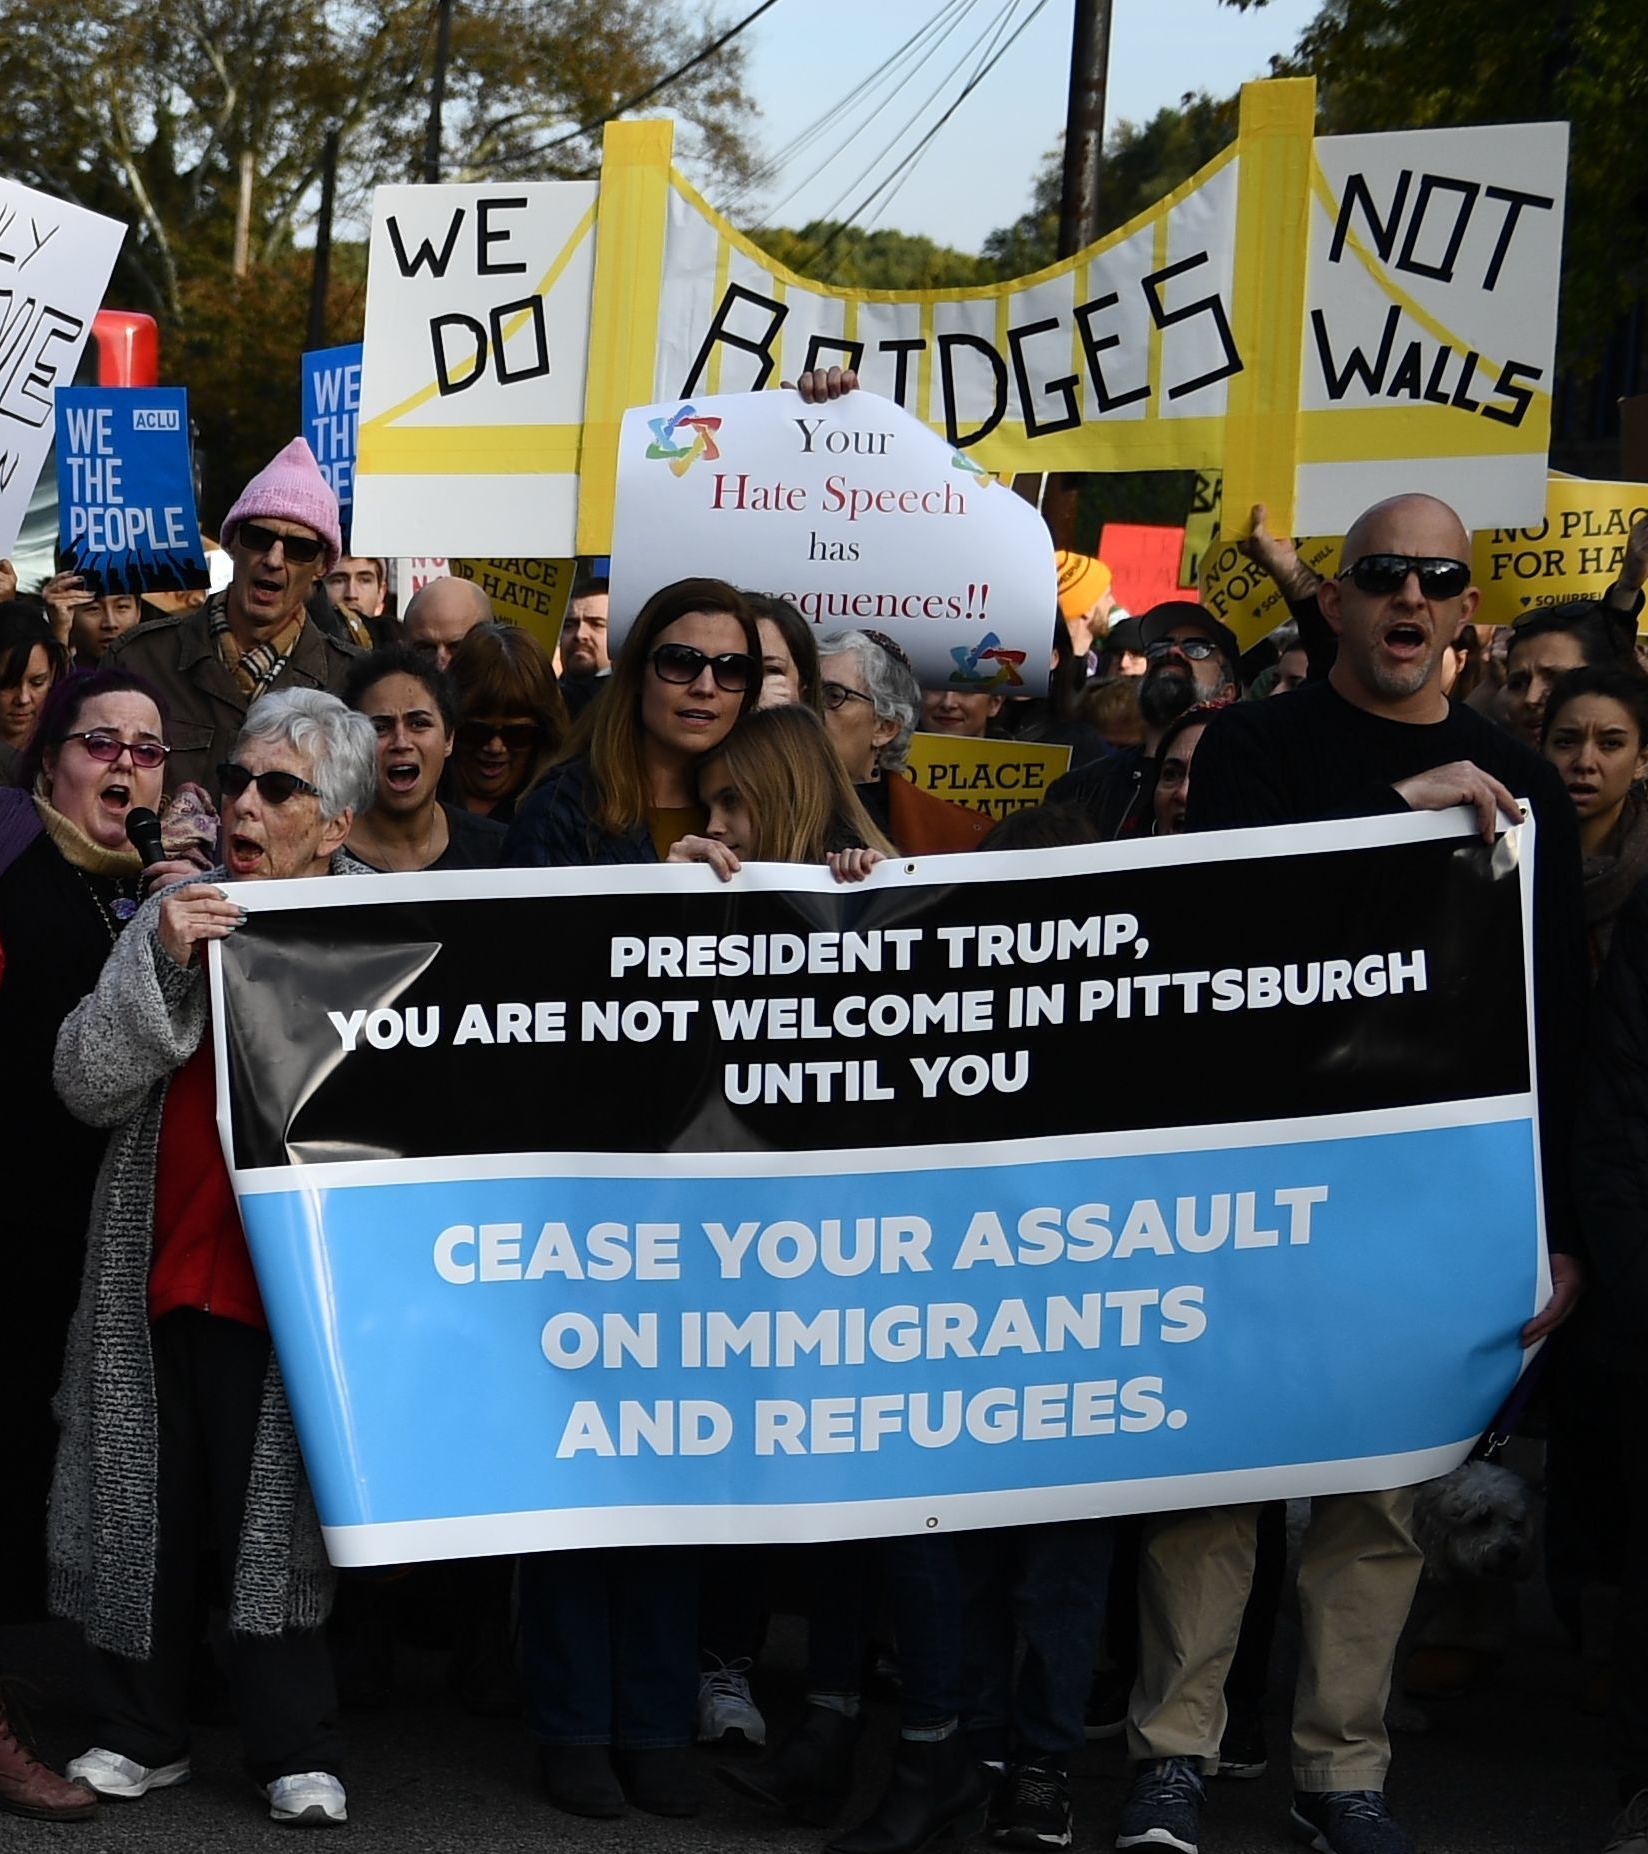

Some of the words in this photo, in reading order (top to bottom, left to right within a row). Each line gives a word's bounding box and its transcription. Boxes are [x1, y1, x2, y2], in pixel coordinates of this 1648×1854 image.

[386, 198, 527, 278] WE
[1329, 169, 1554, 291] NOT
[430, 294, 550, 397] DO
[1310, 304, 1543, 428] WALLS
[313, 364, 361, 415] WE
[66, 408, 113, 455] WE
[135, 411, 177, 429] ACLU
[793, 417, 895, 455] Your
[66, 457, 124, 505] THE
[710, 472, 807, 512] Hate
[821, 474, 967, 521] Speech
[70, 506, 189, 553] PEOPLE
[808, 531, 860, 562] has
[1491, 549, 1566, 581] FOR
[482, 573, 551, 617] HATE
[927, 763, 1045, 790] PLACE
[610, 928, 923, 978] PRESIDENT
[936, 913, 1150, 969] TRUMP,
[326, 1003, 449, 1054] YOU
[452, 1001, 567, 1046] ARE
[581, 1000, 700, 1043] NOT
[711, 989, 995, 1041] WELCOME
[1008, 983, 1065, 1029] IN
[1079, 949, 1428, 1022] PITTSBURGH
[724, 1059, 895, 1105] UNTIL
[909, 1049, 1029, 1098] YOU
[433, 1222, 681, 1285] CEASE
[701, 1215, 933, 1279] YOUR
[952, 1185, 1329, 1270] ASSAULT
[541, 1311, 658, 1370] ON
[681, 1285, 1207, 1368] IMMIGRANTS
[555, 1399, 734, 1459] AND
[754, 1375, 1188, 1456] REFUGEES.
